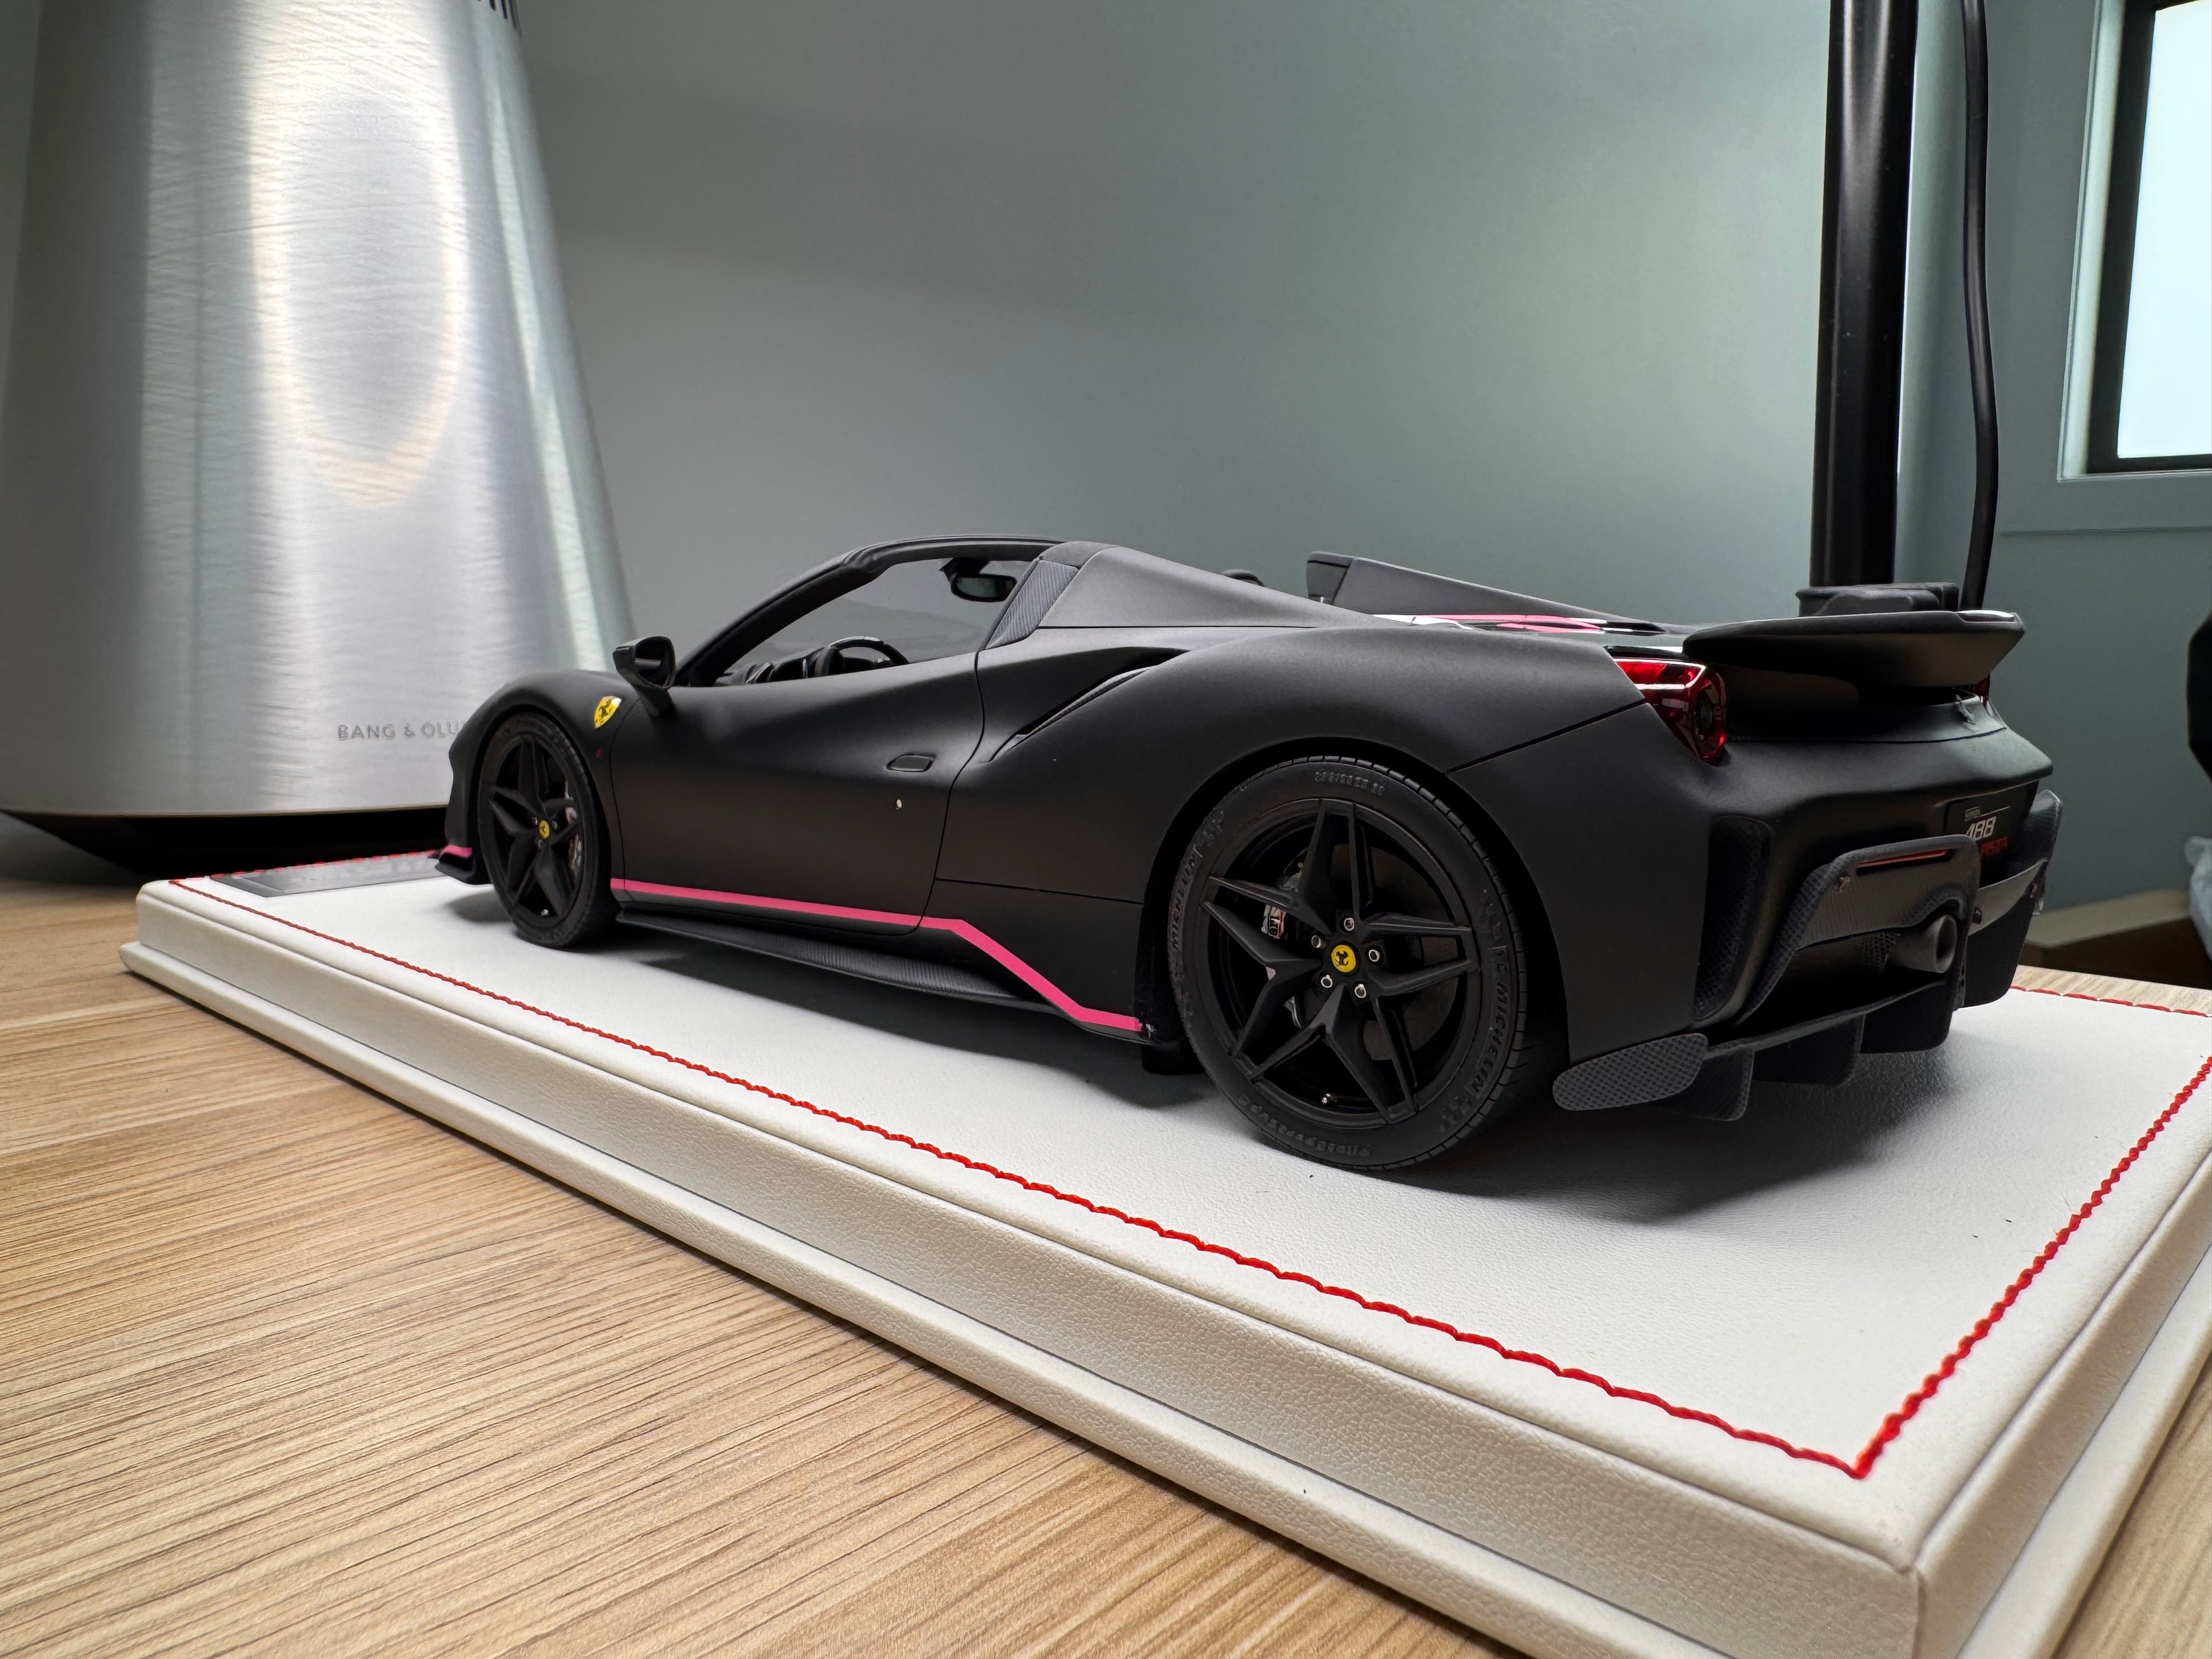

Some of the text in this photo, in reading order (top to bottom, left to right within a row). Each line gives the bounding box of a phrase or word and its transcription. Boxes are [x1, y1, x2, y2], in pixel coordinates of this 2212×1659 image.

[338, 724, 396, 741] BANG
[404, 723, 415, 738] &
[1966, 816, 1997, 841] 488
